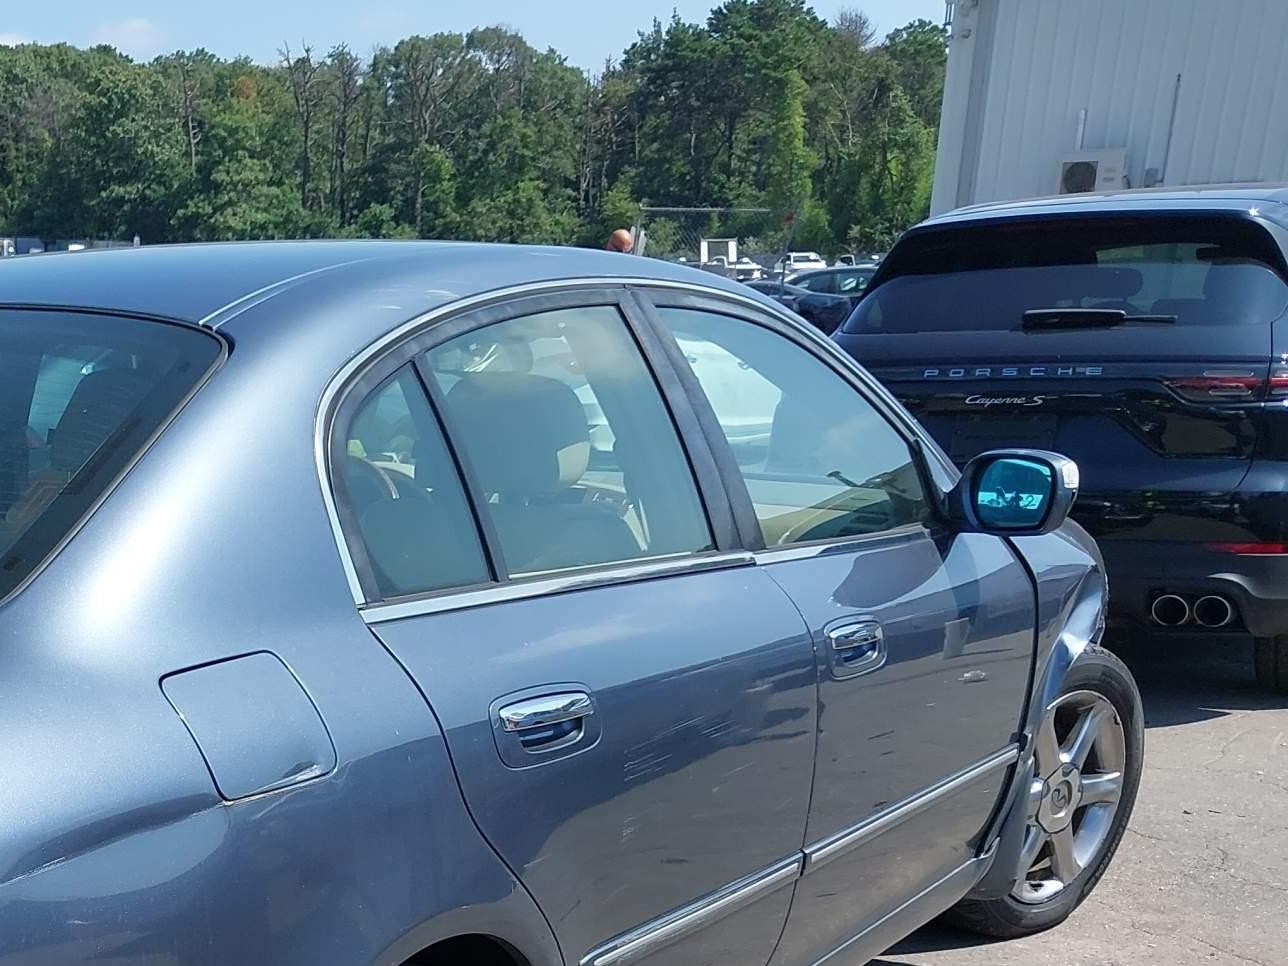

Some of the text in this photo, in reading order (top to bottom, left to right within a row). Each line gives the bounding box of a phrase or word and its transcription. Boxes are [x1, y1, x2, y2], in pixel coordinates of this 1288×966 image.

[923, 367, 1103, 378] PORSCHE
[964, 394, 1047, 408] Cayenne S
